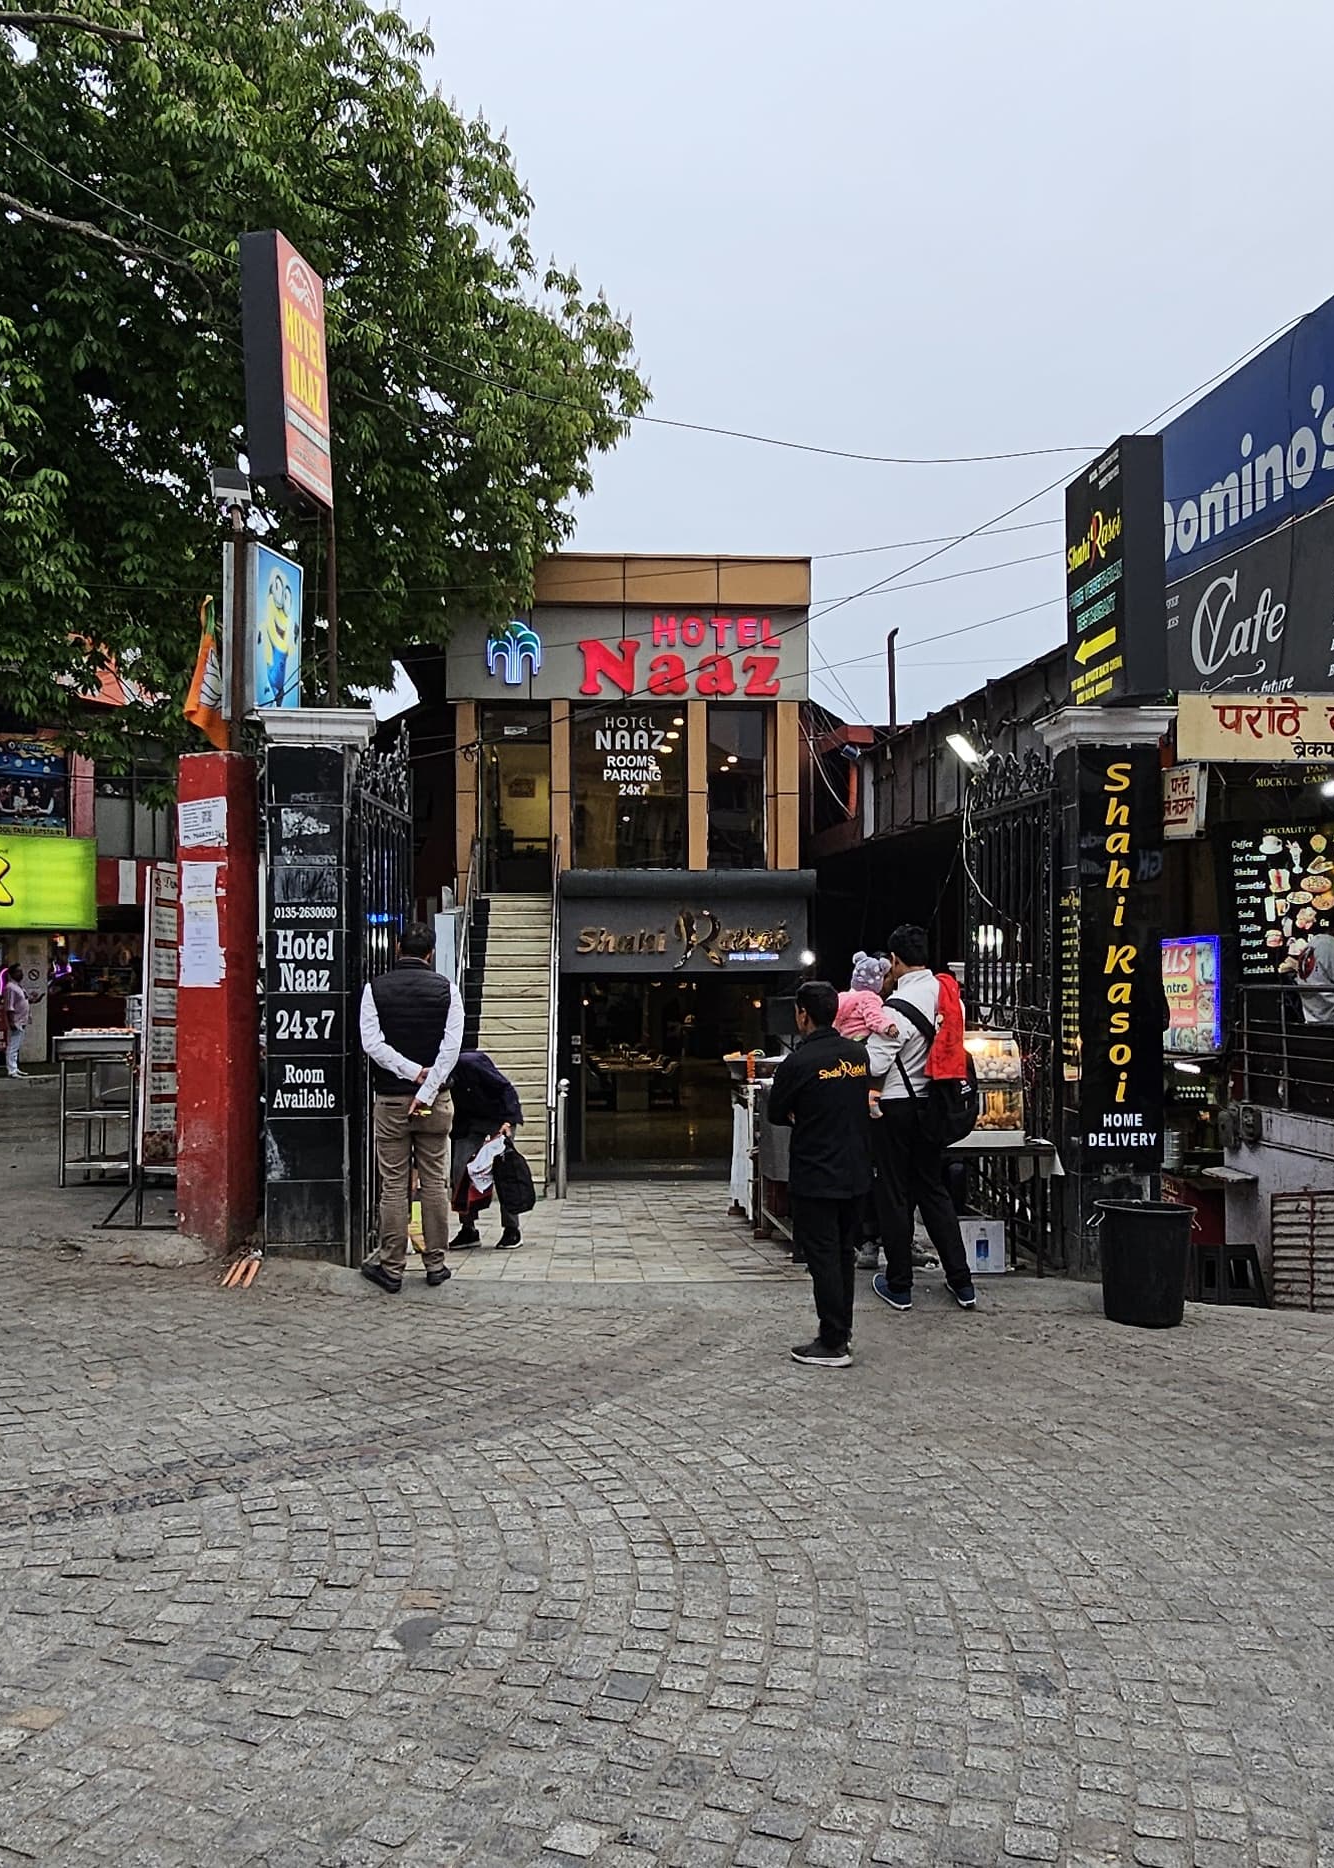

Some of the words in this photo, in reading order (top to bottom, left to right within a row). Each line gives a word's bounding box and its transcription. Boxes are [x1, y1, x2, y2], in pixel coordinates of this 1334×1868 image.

[284, 297, 325, 373] HOTEL
[289, 351, 324, 420] NAAZ
[1067, 529, 1091, 576] Shahi
[652, 615, 782, 649] HOTEL
[578, 639, 782, 697] Naaz
[605, 716, 656, 729] HOTEL
[594, 729, 666, 751] NAAZ
[606, 755, 657, 769] ROOMS
[603, 769, 662, 782] PARKING
[618, 783, 649, 797] 24x7
[1102, 762, 1133, 928] Shahi
[1231, 840, 1254, 849] Coffee
[1232, 854, 1244, 863] Ice
[275, 929, 335, 961] Hotel
[575, 926, 667, 954] Shahi
[279, 963, 331, 993] Naaz
[1164, 982, 1189, 994] ntre
[274, 1009, 335, 1041] 24x7
[1102, 943, 1138, 1104] Rasoi
[284, 1063, 326, 1085] Room
[272, 1089, 335, 1110] Available
[1102, 1113, 1144, 1128] HOME
[1088, 1131, 1158, 1148] DELIVERY
